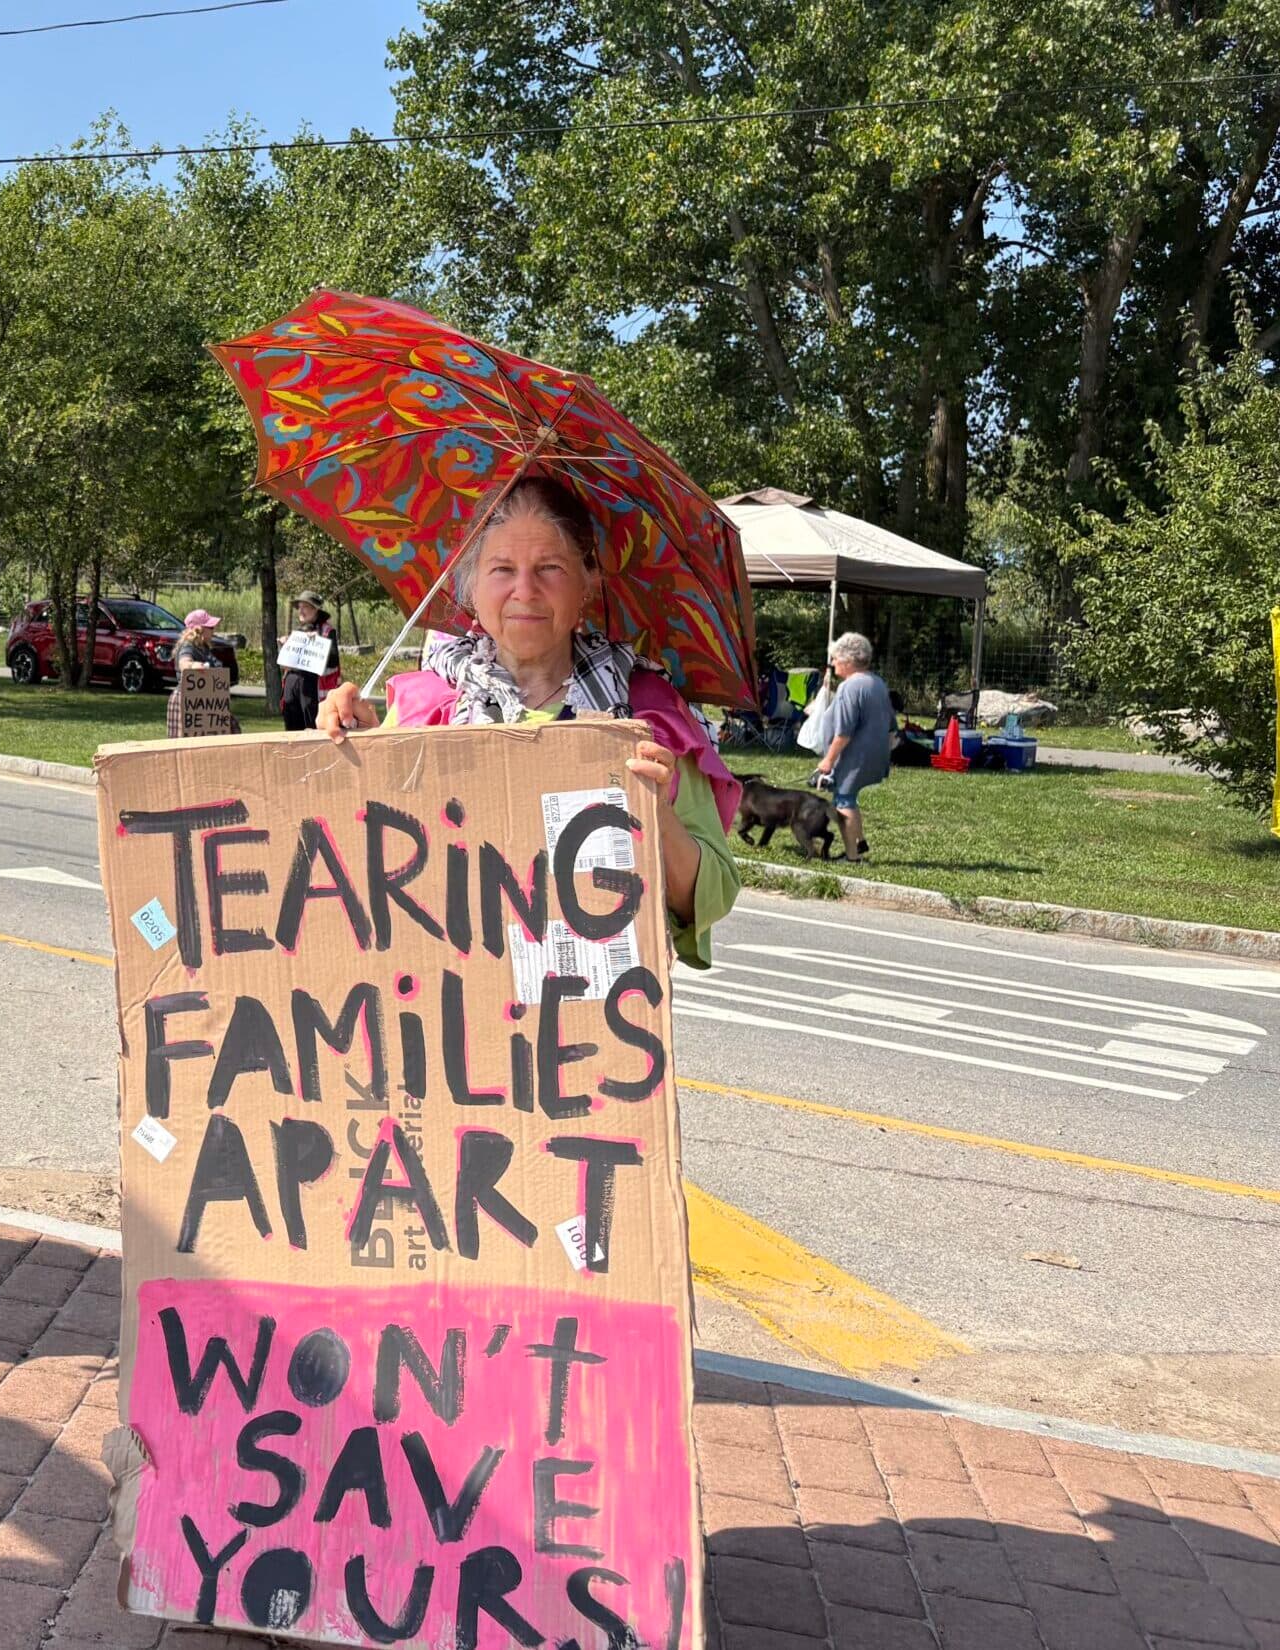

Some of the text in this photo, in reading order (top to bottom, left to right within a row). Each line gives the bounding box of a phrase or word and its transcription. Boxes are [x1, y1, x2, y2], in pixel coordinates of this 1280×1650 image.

[185, 697, 230, 712] WANNA
[185, 713, 203, 728] BE
[176, 1113, 645, 1273] APART
[228, 1410, 606, 1561] SAVE
